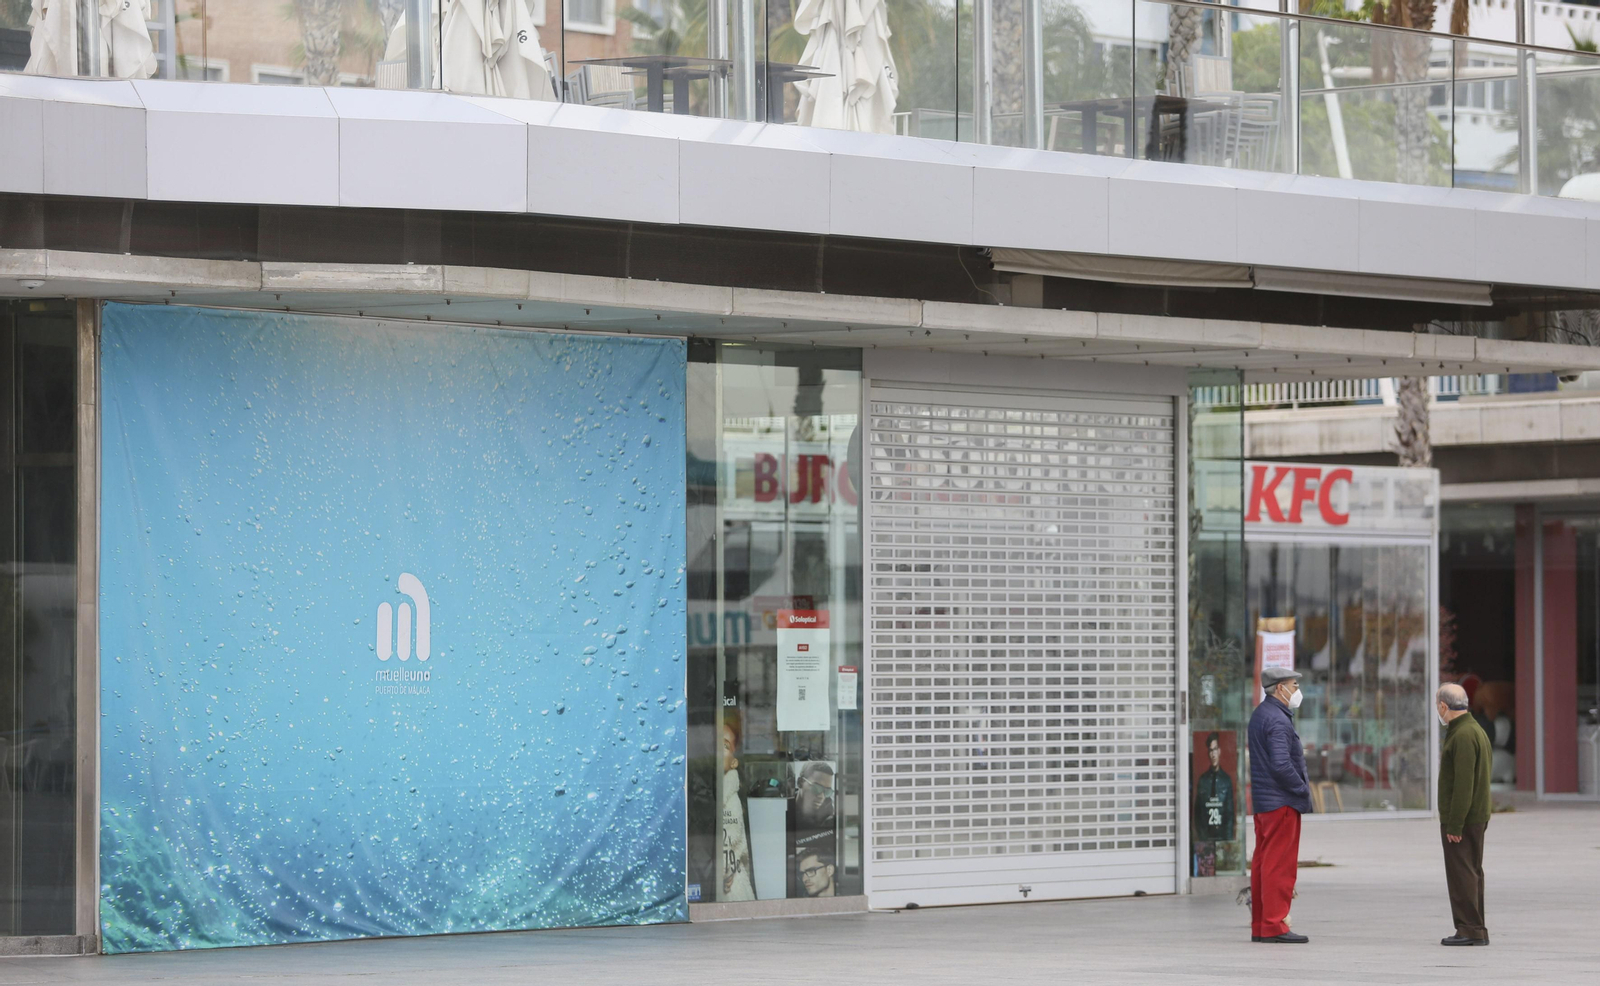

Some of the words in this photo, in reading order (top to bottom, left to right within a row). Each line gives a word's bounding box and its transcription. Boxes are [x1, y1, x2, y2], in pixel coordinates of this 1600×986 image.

[1244, 465, 1353, 525] KFC
[795, 615, 817, 624] Soloptical
[375, 666, 431, 682] muelleuno
[375, 685, 399, 695] PUERTO
[399, 685, 407, 695] DE
